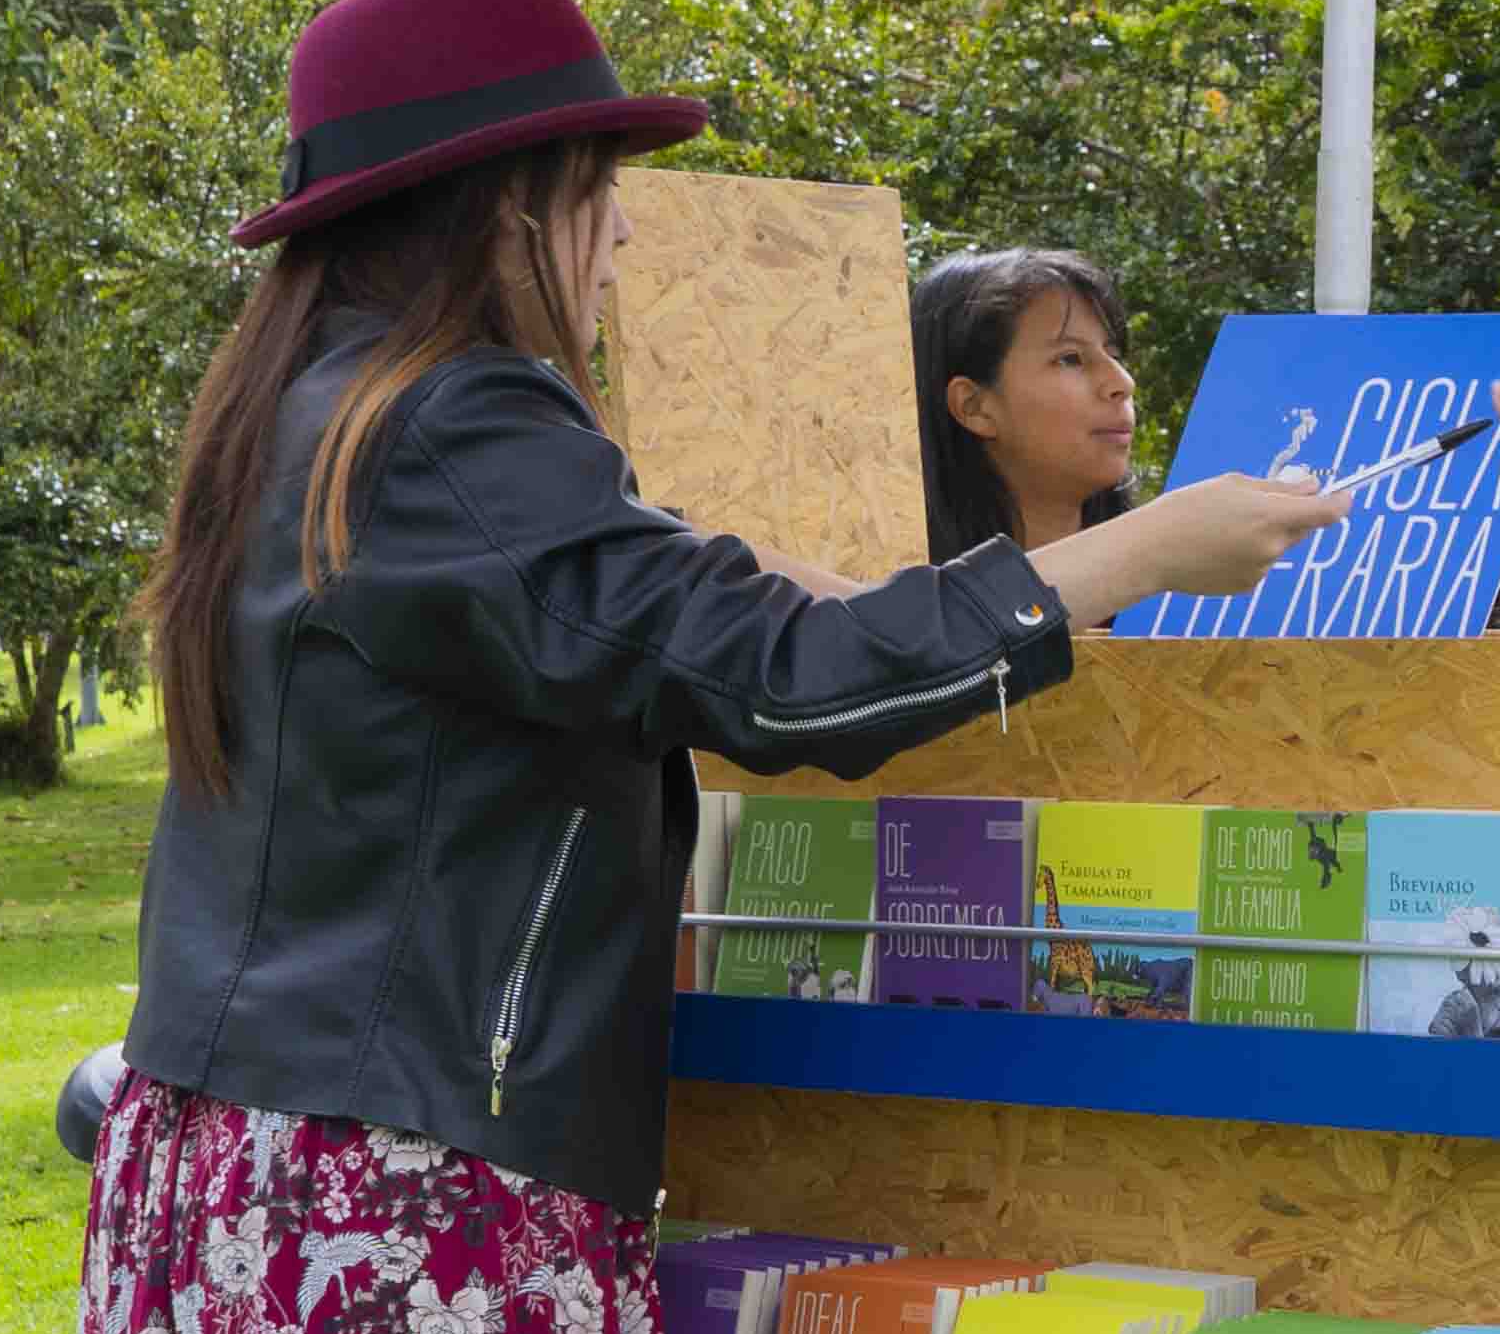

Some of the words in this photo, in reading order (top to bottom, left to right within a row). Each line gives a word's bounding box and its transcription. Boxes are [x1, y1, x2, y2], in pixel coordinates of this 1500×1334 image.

[744, 820, 813, 886] PACO
[884, 822, 912, 879] DE
[1217, 826, 1238, 869] DE
[1060, 884, 1154, 902] TAMALAMEQUE
[1116, 868, 1133, 880] DE
[1389, 871, 1475, 894] BREVIARIO
[1213, 883, 1233, 928] LA
[1239, 885, 1302, 931] FAMILIA
[1388, 899, 1409, 913] DE
[1414, 899, 1434, 914] LA
[884, 901, 1009, 962] SOBREMESA
[1211, 957, 1263, 1004] CHIMP
[1267, 962, 1308, 1006] VINO
